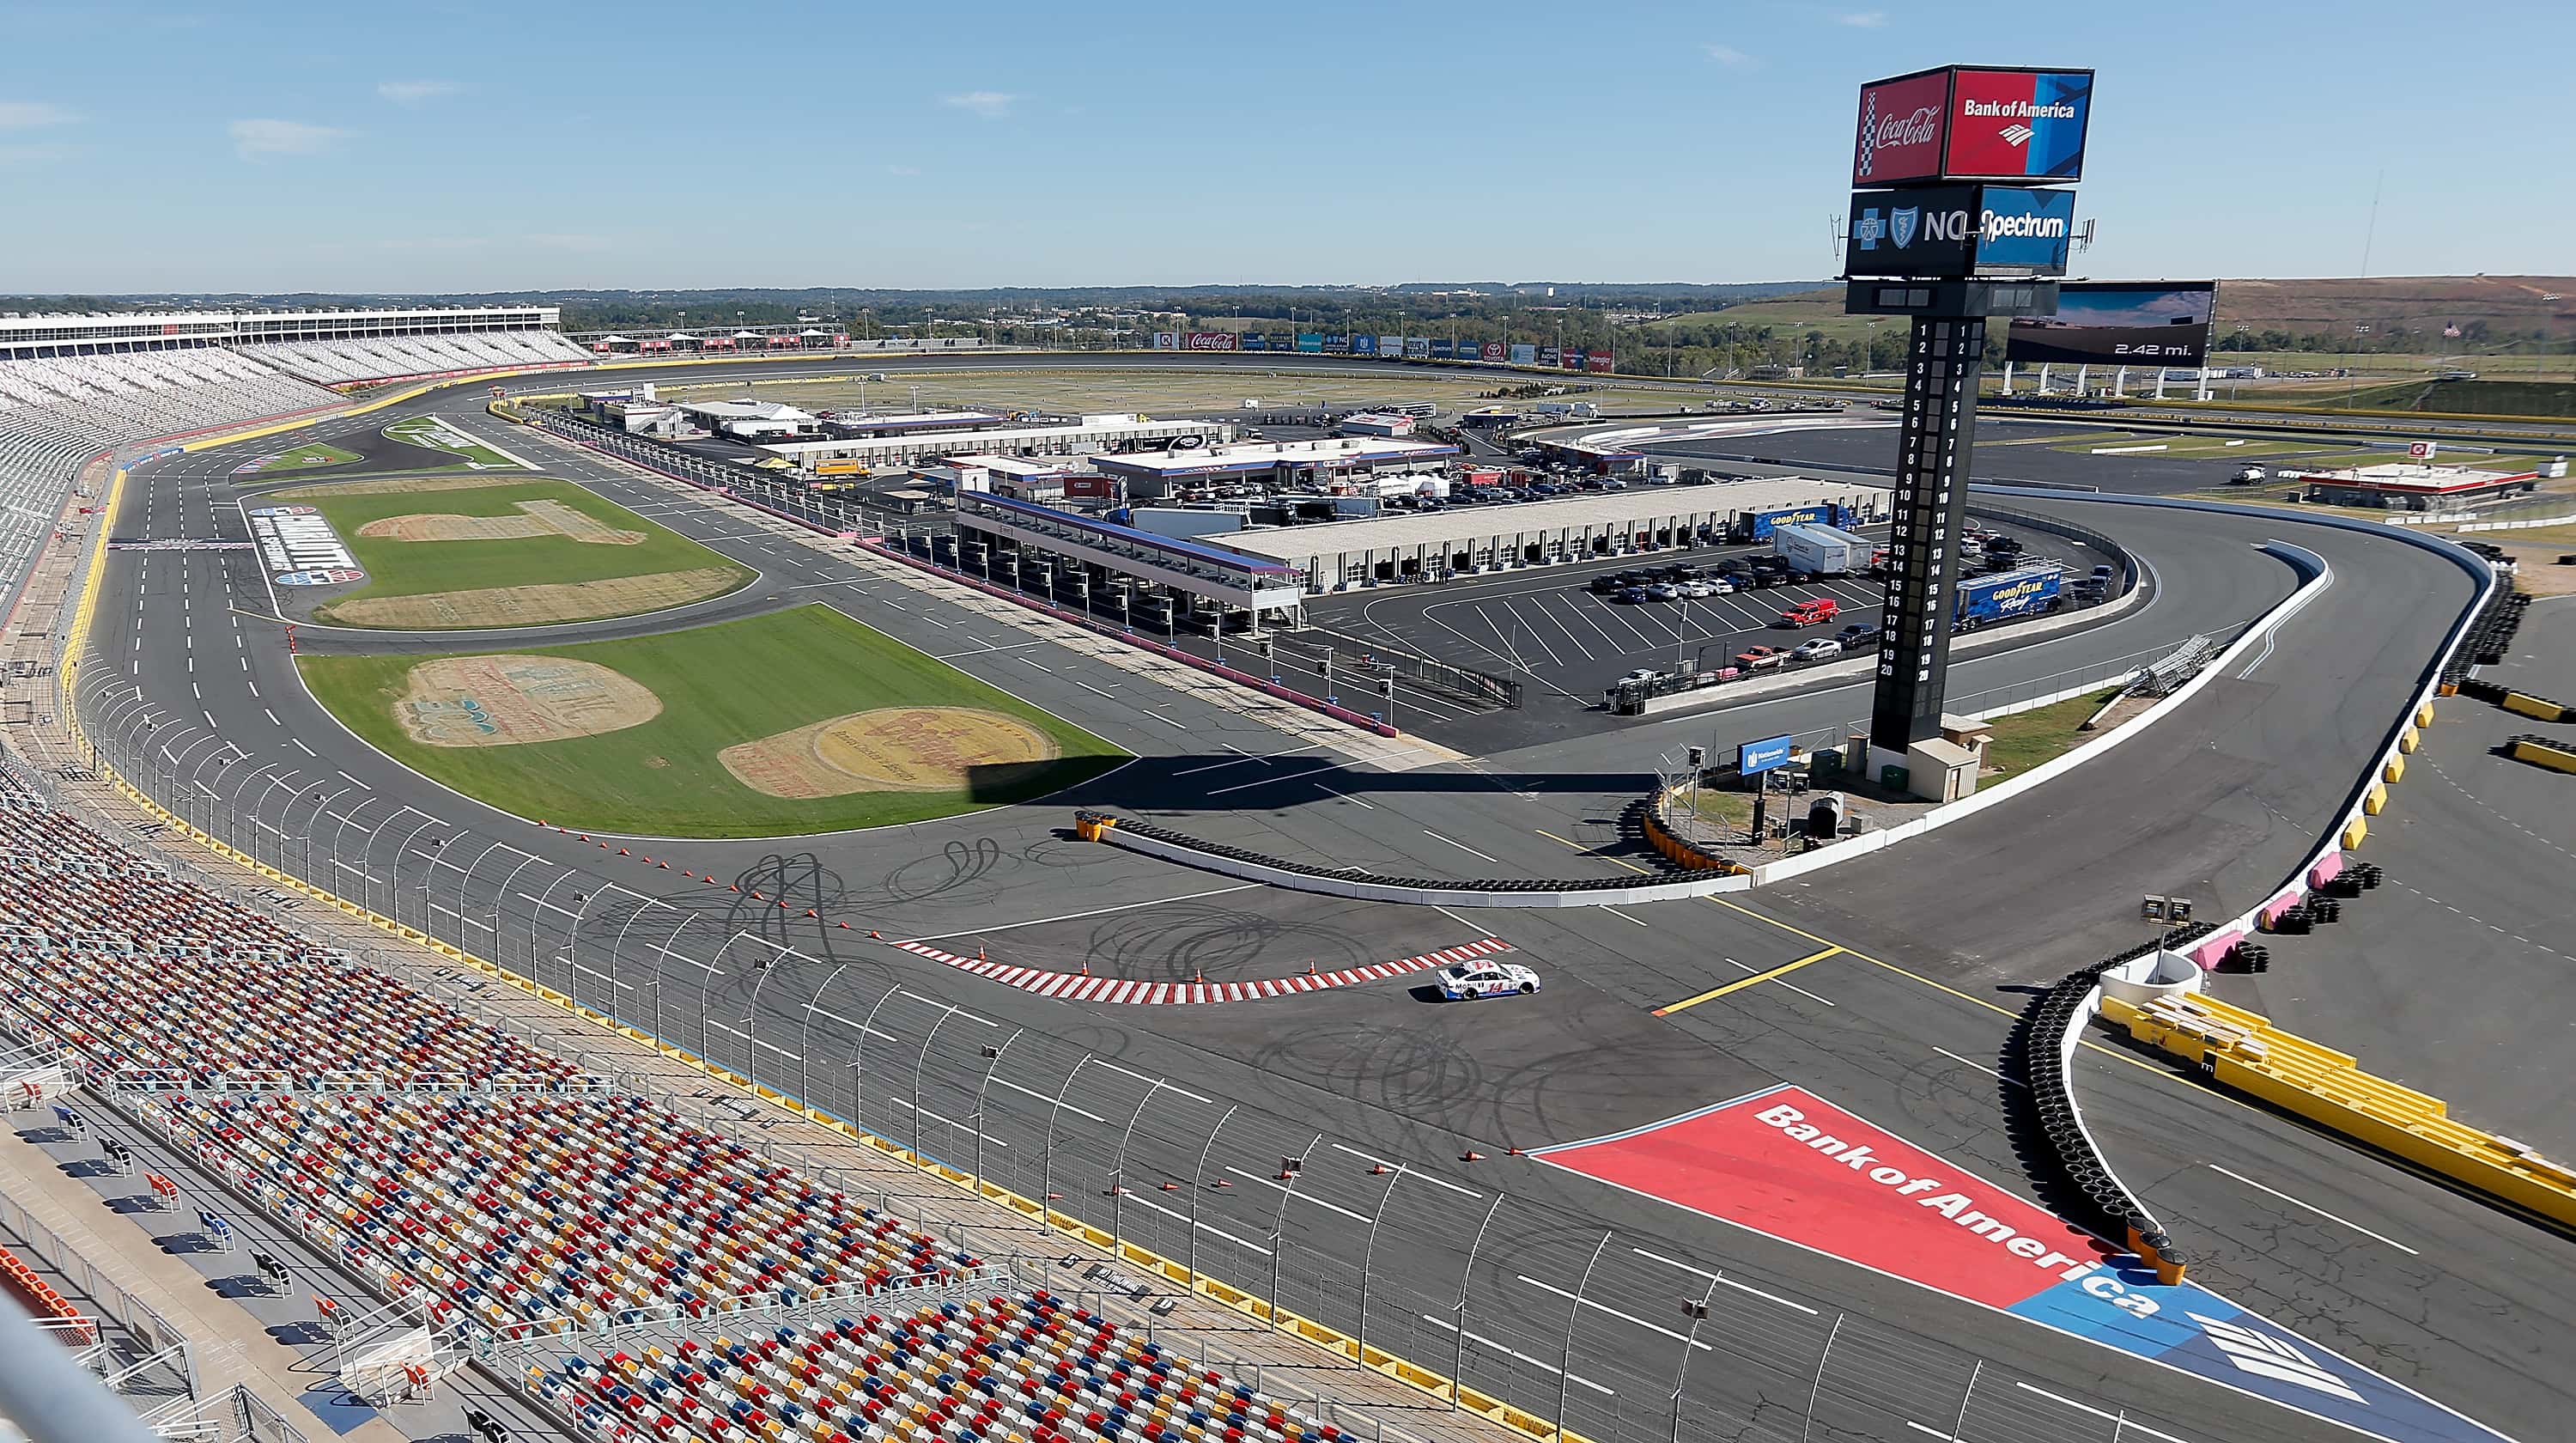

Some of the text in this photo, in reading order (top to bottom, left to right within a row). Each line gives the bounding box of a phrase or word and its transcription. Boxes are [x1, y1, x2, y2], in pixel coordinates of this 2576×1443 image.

[1964, 100, 2075, 119] Bank of America
[1876, 105, 1941, 149] Coca-Cola
[1981, 210, 2063, 242] Spectrum
[1921, 324, 1926, 336] 1
[1961, 325, 1965, 338] 1
[1191, 332, 1235, 350] Coca-Cola
[1918, 341, 1926, 353] 2
[1958, 343, 1965, 355] 2
[2115, 344, 2192, 356] 2.42 mi.
[1589, 356, 1610, 366] Wrangler
[1917, 362, 1924, 374] 3
[1956, 363, 1962, 375] 3
[1915, 380, 1922, 391] 4
[1953, 381, 1960, 393] 4
[1913, 399, 1920, 411] 5
[1952, 400, 1959, 413] 5
[1911, 417, 1918, 429] 6
[1950, 417, 1957, 430] 6
[1910, 436, 1917, 448] 7
[1948, 438, 1955, 450] 7
[1907, 453, 1915, 465] 8
[1946, 455, 1953, 467] 8
[1905, 472, 1912, 484] 9
[1943, 475, 1950, 487] 9
[1899, 489, 1911, 501] 10
[1938, 491, 1948, 504] 10
[1771, 512, 1815, 526] GOODYEAR
[1897, 508, 1908, 521] 11
[1936, 512, 1946, 524] 11
[1895, 525, 1907, 537] 12
[1935, 528, 1945, 540] 12
[1893, 544, 1905, 556] 13
[1932, 547, 1942, 560] 13
[1892, 560, 1904, 572] 14
[1930, 564, 1941, 576] 14
[1890, 579, 1902, 592] 15
[1929, 583, 1939, 595] 15
[1992, 581, 2043, 600] GOODYEAR
[1888, 595, 1900, 607] 16
[1927, 600, 1937, 612] 16
[1886, 614, 1898, 626] 17
[1924, 618, 1935, 630] 17
[1885, 630, 1897, 642] 18
[1923, 635, 1933, 647] 18
[1883, 648, 1894, 661] 19
[1921, 653, 1931, 666] 19
[1880, 664, 1893, 676] 20
[1918, 669, 1929, 682] 20
[1488, 982, 1504, 994] 14
[1753, 1104, 2164, 1321] Bank of America
